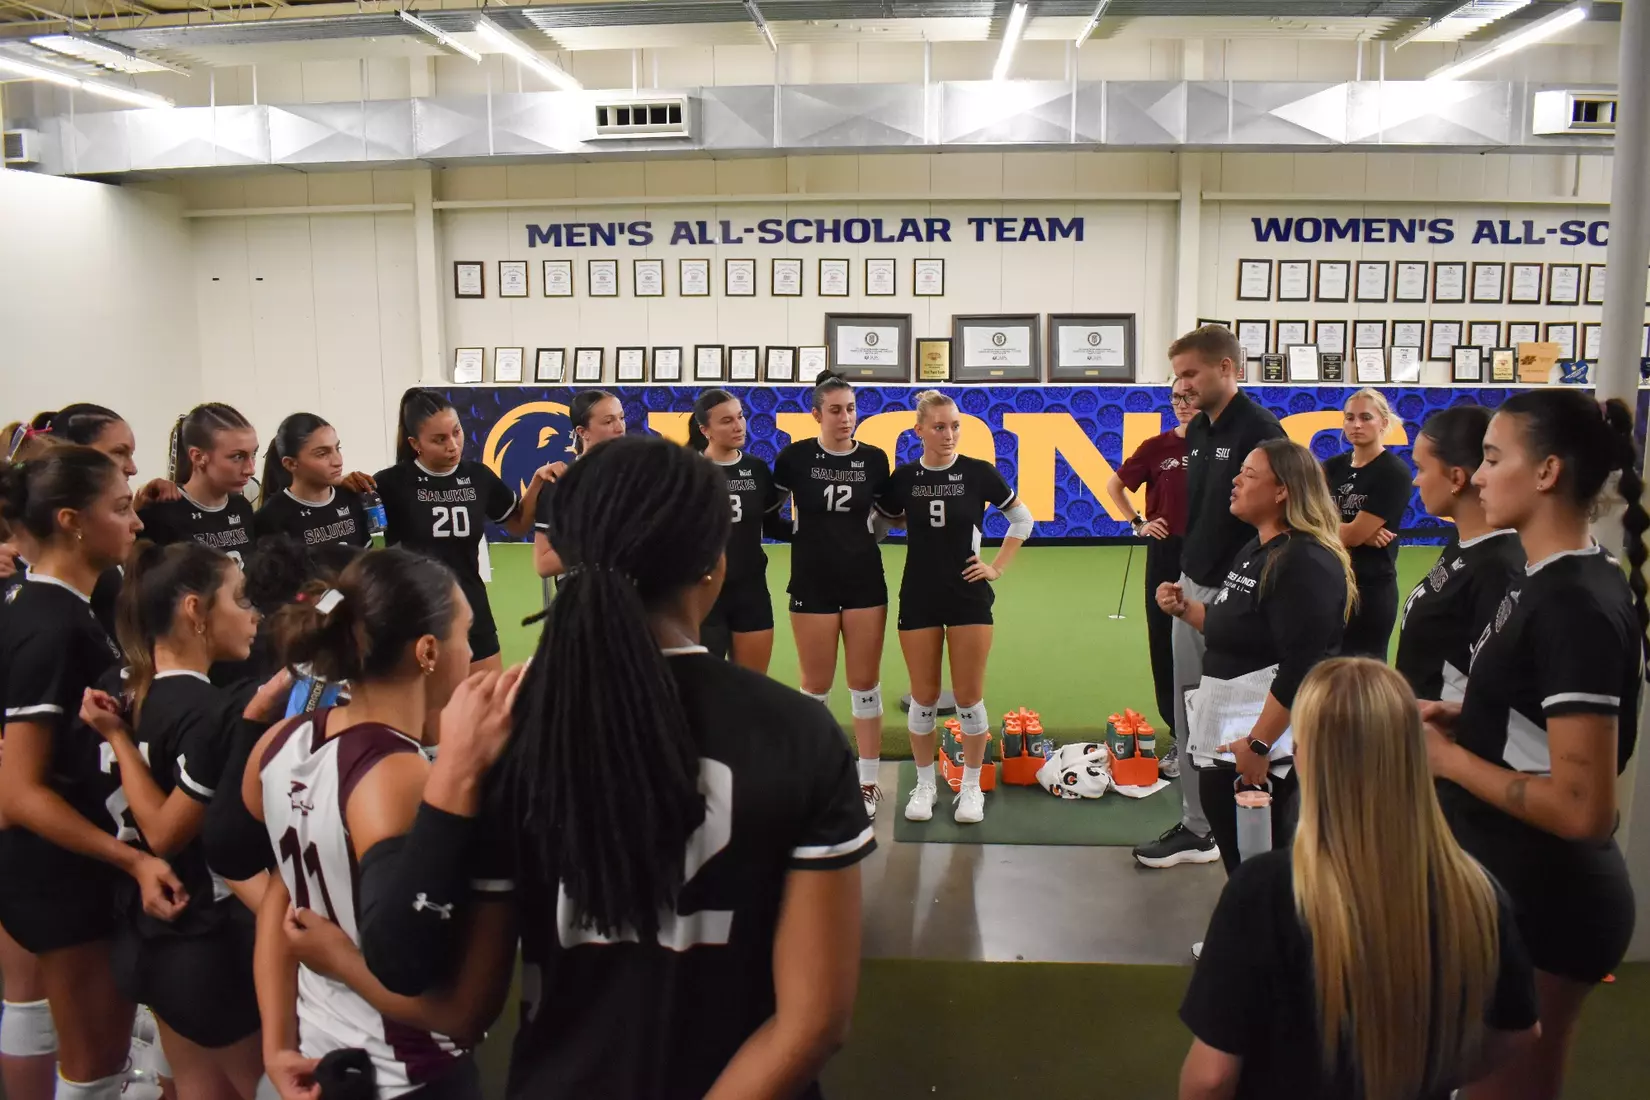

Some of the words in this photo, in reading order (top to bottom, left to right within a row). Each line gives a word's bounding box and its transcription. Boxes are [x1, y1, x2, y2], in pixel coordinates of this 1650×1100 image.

[527, 222, 653, 248] MEN'S
[670, 218, 951, 245] ALL-SCHOLAR
[968, 217, 1084, 242] TEAM
[1251, 217, 1455, 244] WOMEN'S
[811, 466, 867, 482] SALUKIS
[417, 487, 477, 502] SALUKIS
[823, 484, 853, 512] 12
[911, 483, 965, 497] SALUKIS
[431, 506, 471, 538] 20
[929, 499, 946, 528] 9
[303, 518, 356, 545] SALUKIS
[279, 825, 340, 925] 11
